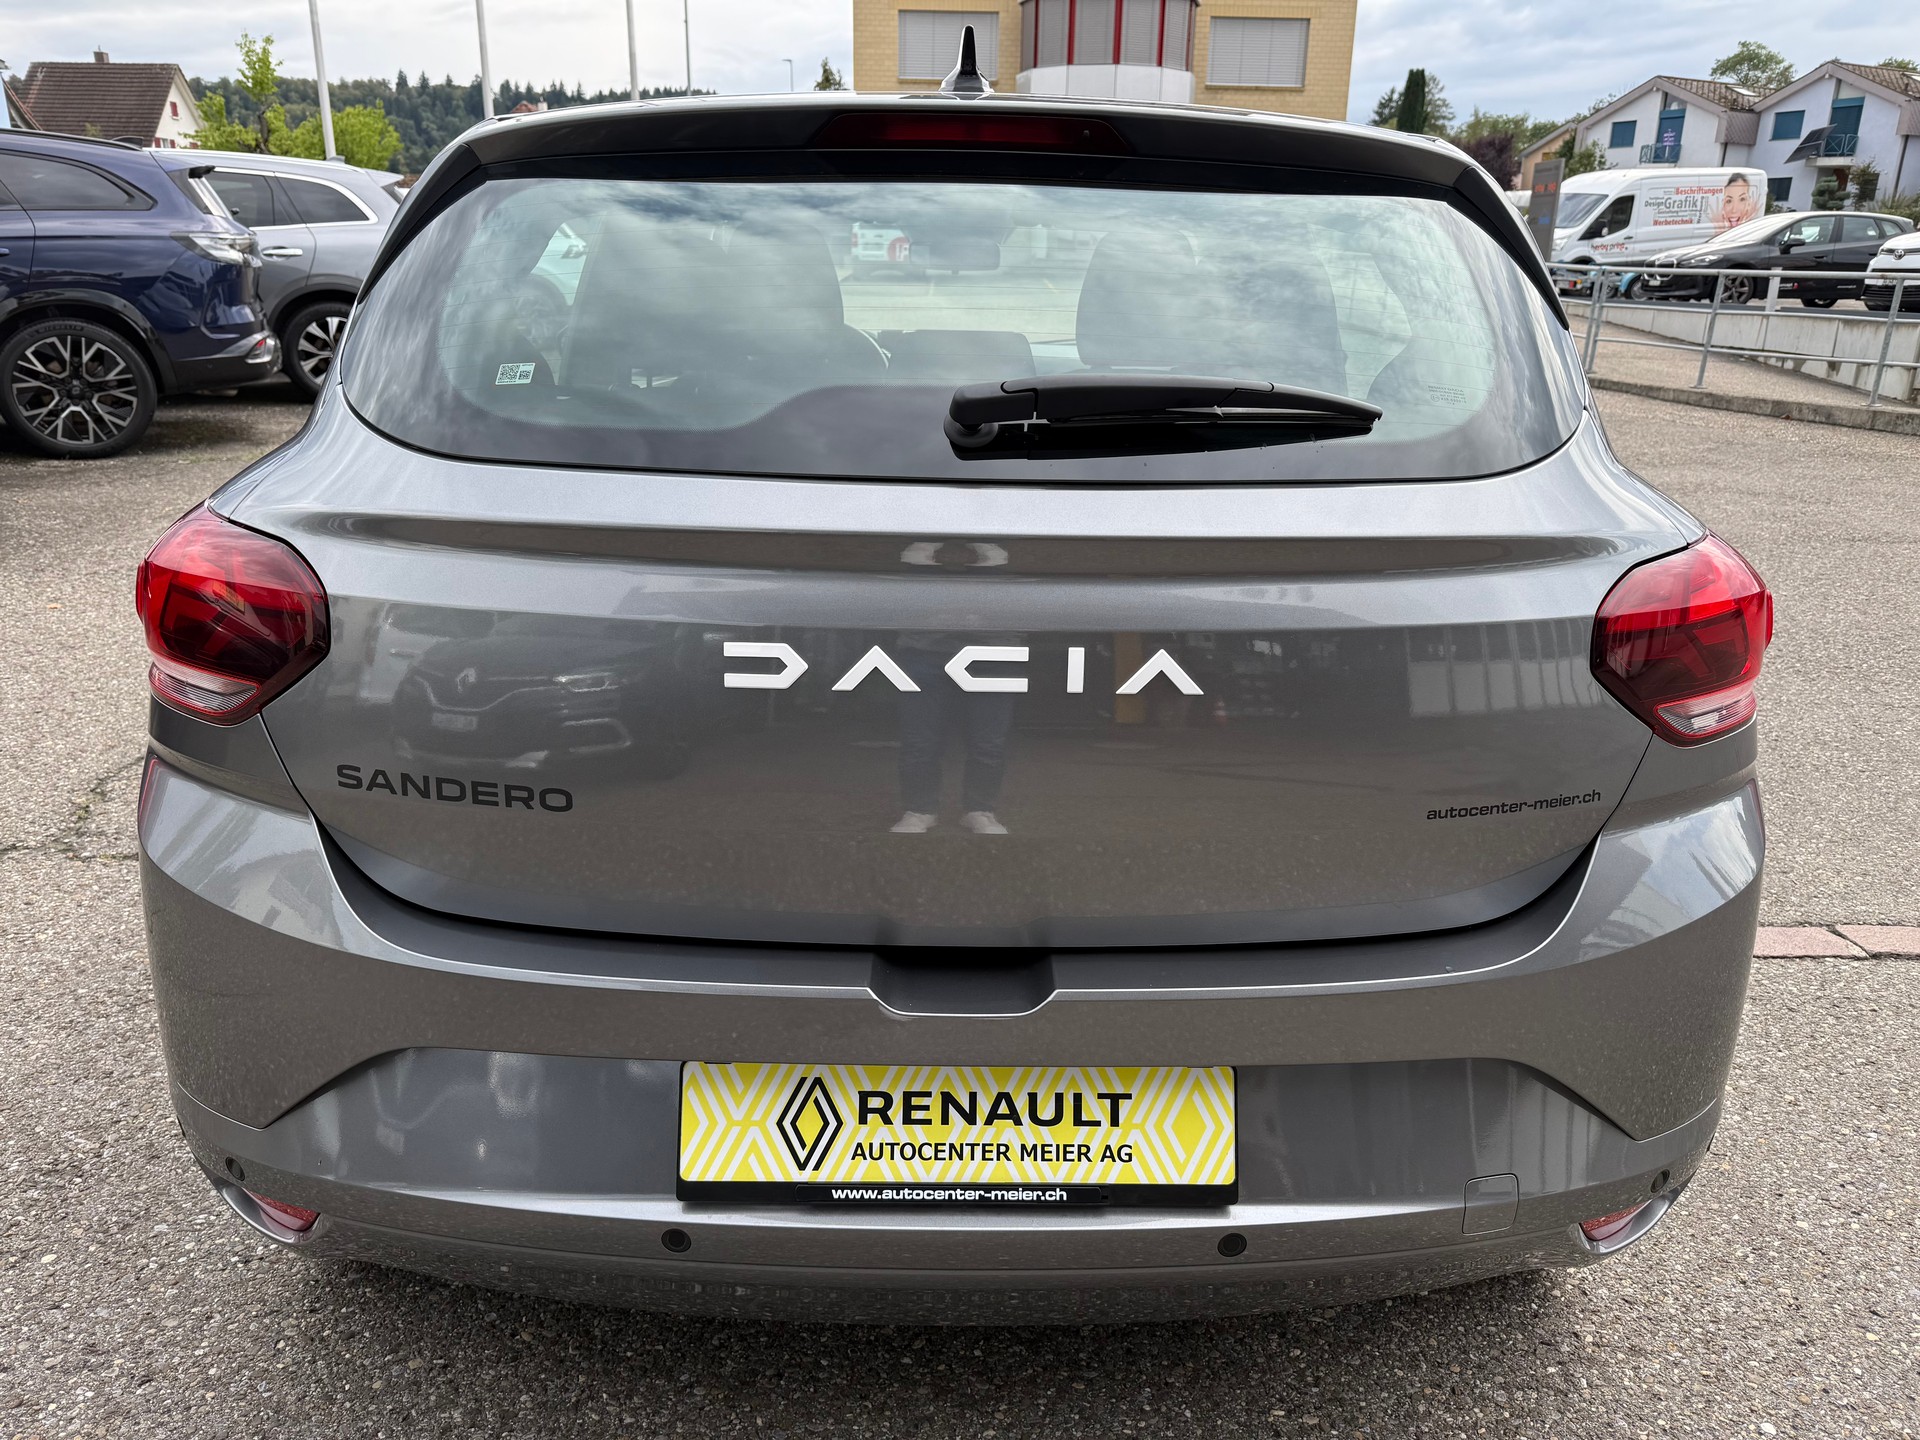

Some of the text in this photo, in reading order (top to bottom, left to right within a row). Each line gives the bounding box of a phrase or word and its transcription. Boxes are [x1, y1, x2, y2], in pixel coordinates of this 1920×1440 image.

[1675, 186, 1723, 195] Beschriftungen
[1645, 200, 1664, 209] Design
[1664, 196, 1698, 209] Grafik
[1653, 218, 1693, 226] Werbetechnik
[723, 641, 1205, 695] DACIA
[336, 764, 574, 813] SANDERO
[1426, 789, 1601, 820] autocenter-meier.ch
[858, 1090, 1133, 1128] RENAULT
[851, 1142, 1133, 1163] AUTOCENTER MEIER AG
[831, 1187, 1067, 1201] www.autocenter-meier.ch
